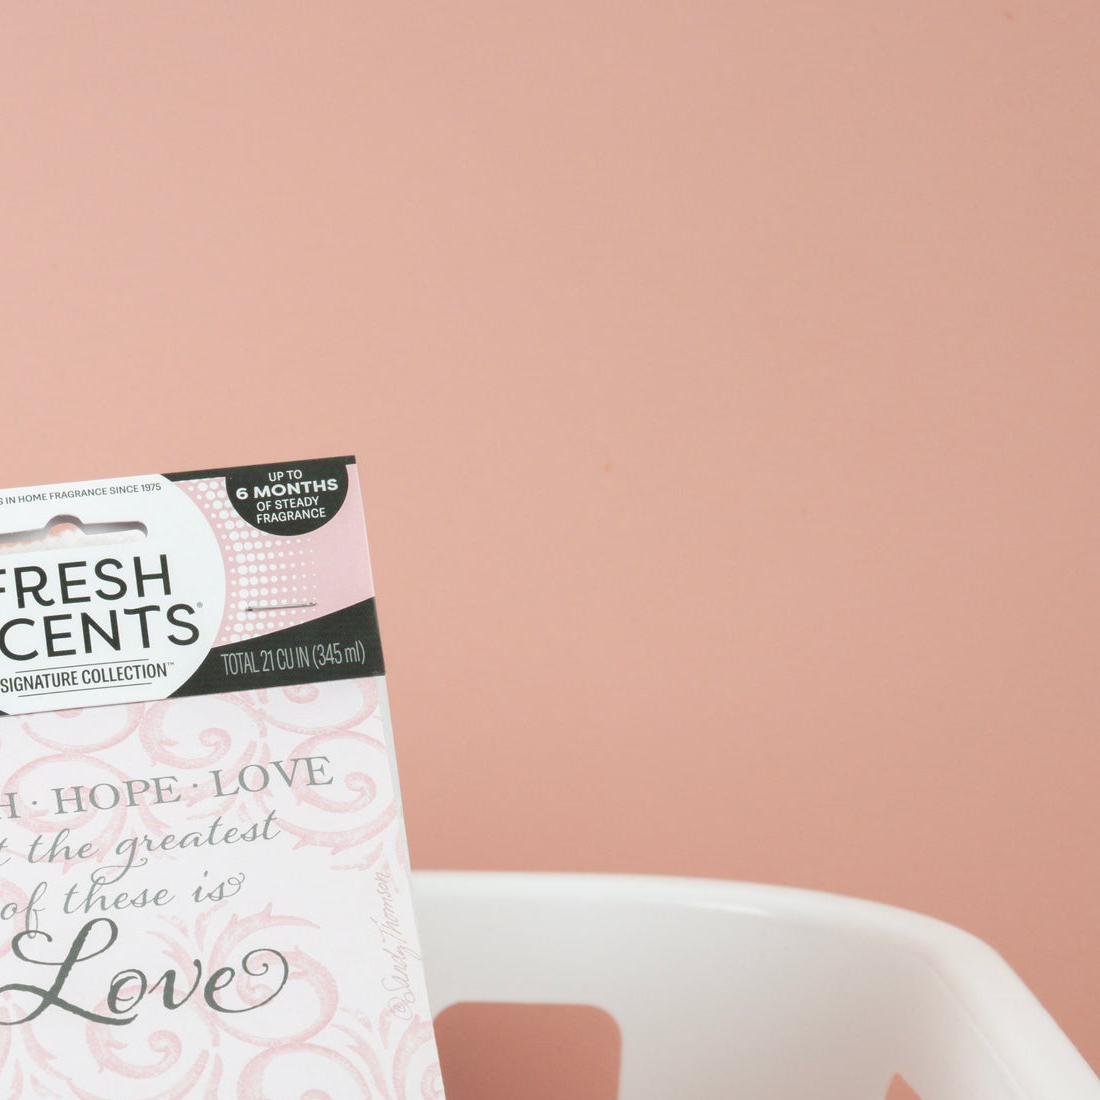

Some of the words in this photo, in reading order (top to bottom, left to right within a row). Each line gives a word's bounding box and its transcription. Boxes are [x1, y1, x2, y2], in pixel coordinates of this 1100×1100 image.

[268, 471, 284, 482] UP
[286, 469, 303, 480] TO
[6, 496, 16, 505] IN
[18, 492, 48, 503] HOME
[49, 487, 108, 500] FRAGRANCE
[110, 484, 139, 495] SINCE
[141, 483, 162, 492] 1975
[236, 487, 249, 500] 6
[253, 478, 339, 499] MONTHS
[256, 500, 272, 512] OF
[275, 496, 320, 510] STEADY
[256, 507, 327, 524] FRAGRANCE
[220, 652, 260, 676] TOTAL
[260, 650, 275, 672] 21
[276, 648, 294, 671] CU
[295, 646, 310, 668] IN
[312, 643, 343, 670] (345
[344, 640, 366, 665] ml)
[0, 670, 78, 693] SIGNATURE
[51, 775, 182, 814] HOPE
[209, 756, 334, 798] LOVE
[27, 828, 99, 864] the
[91, 809, 282, 886] greatest
[0, 881, 48, 939] of
[63, 876, 175, 914] these
[192, 870, 246, 902] is
